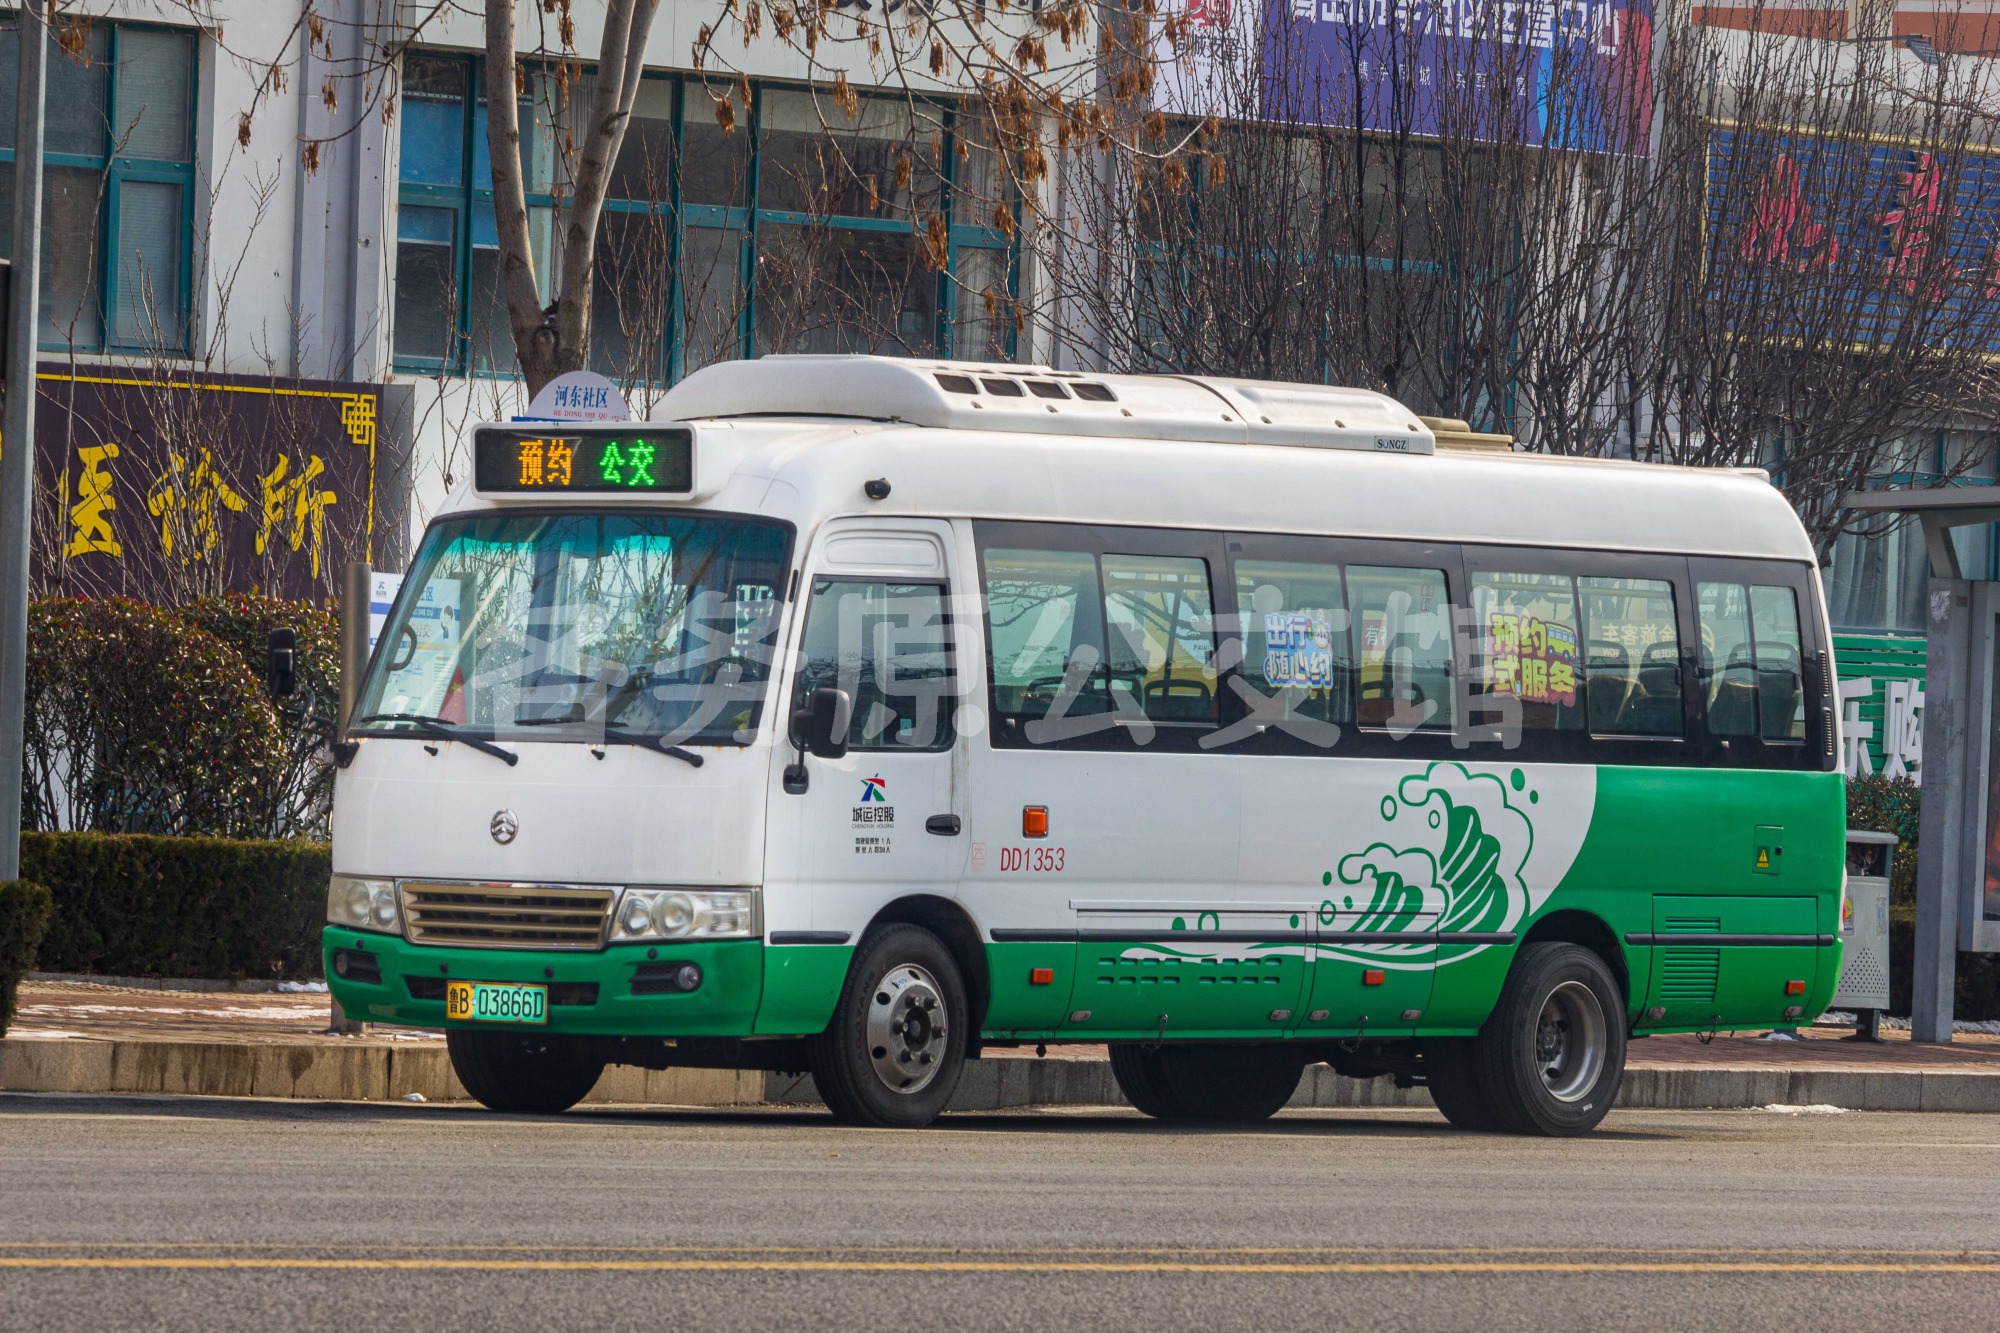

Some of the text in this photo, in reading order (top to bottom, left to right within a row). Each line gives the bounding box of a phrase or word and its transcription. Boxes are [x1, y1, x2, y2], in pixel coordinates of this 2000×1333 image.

[555, 385, 609, 409] 河东社区
[1377, 439, 1406, 450] SONGZ
[518, 439, 655, 486] 预约 公交
[1266, 614, 1307, 649] 出行
[1491, 614, 1547, 658] 预约
[1267, 648, 1332, 684] 随心约
[1493, 654, 1576, 698] 式服务
[852, 806, 895, 822] 城运控股
[1000, 847, 1065, 872] DD1353
